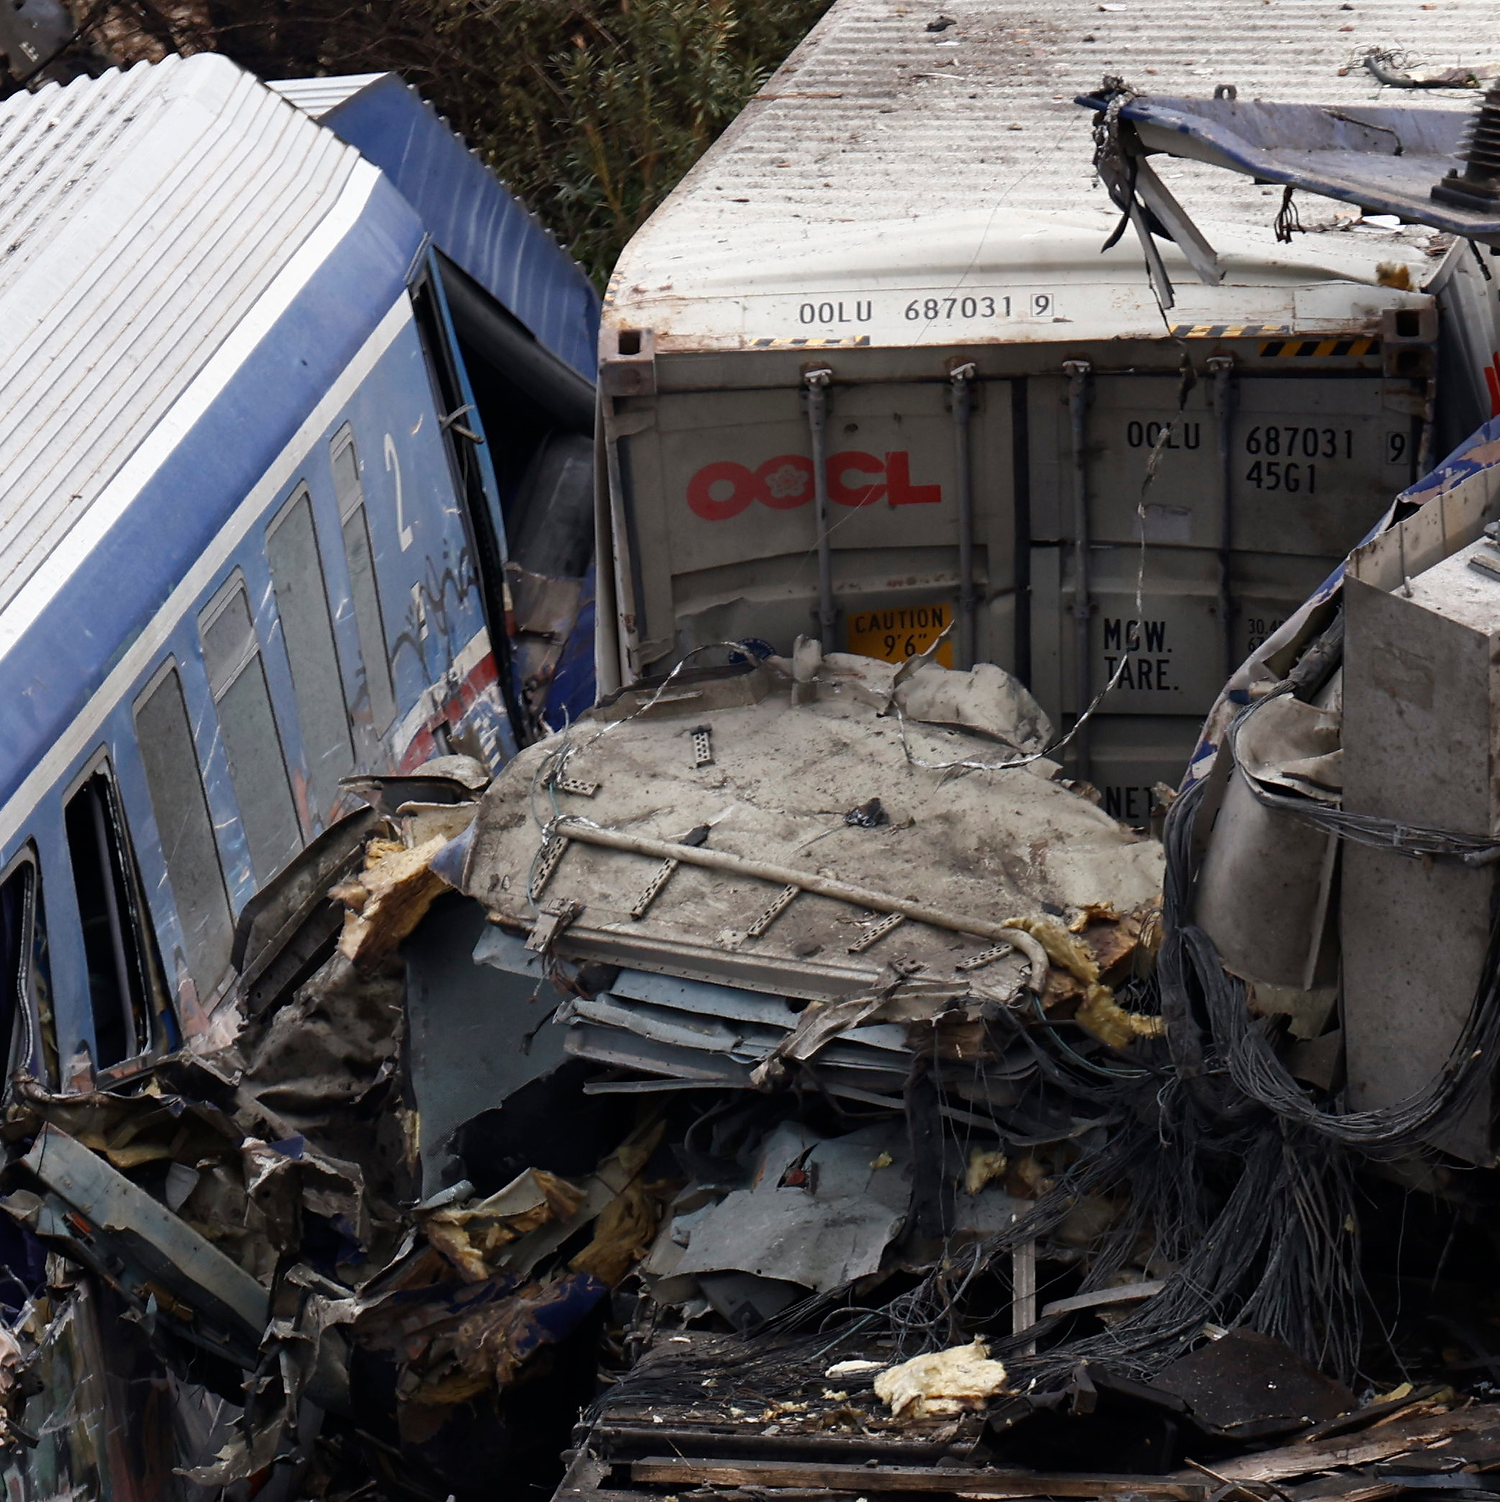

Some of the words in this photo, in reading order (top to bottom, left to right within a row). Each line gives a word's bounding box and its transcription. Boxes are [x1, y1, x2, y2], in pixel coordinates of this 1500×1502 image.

[800, 300, 872, 324] OOLU
[904, 295, 1011, 321] 687031
[1033, 294, 1051, 316] 9
[1245, 425, 1353, 460] 687031
[1388, 432, 1407, 463] 9
[685, 450, 942, 522] OOCL
[1245, 459, 1316, 494] 45G1
[854, 607, 944, 635] CAUTION
[1103, 618, 1173, 653] MGW.
[1103, 656, 1180, 692] TARE.
